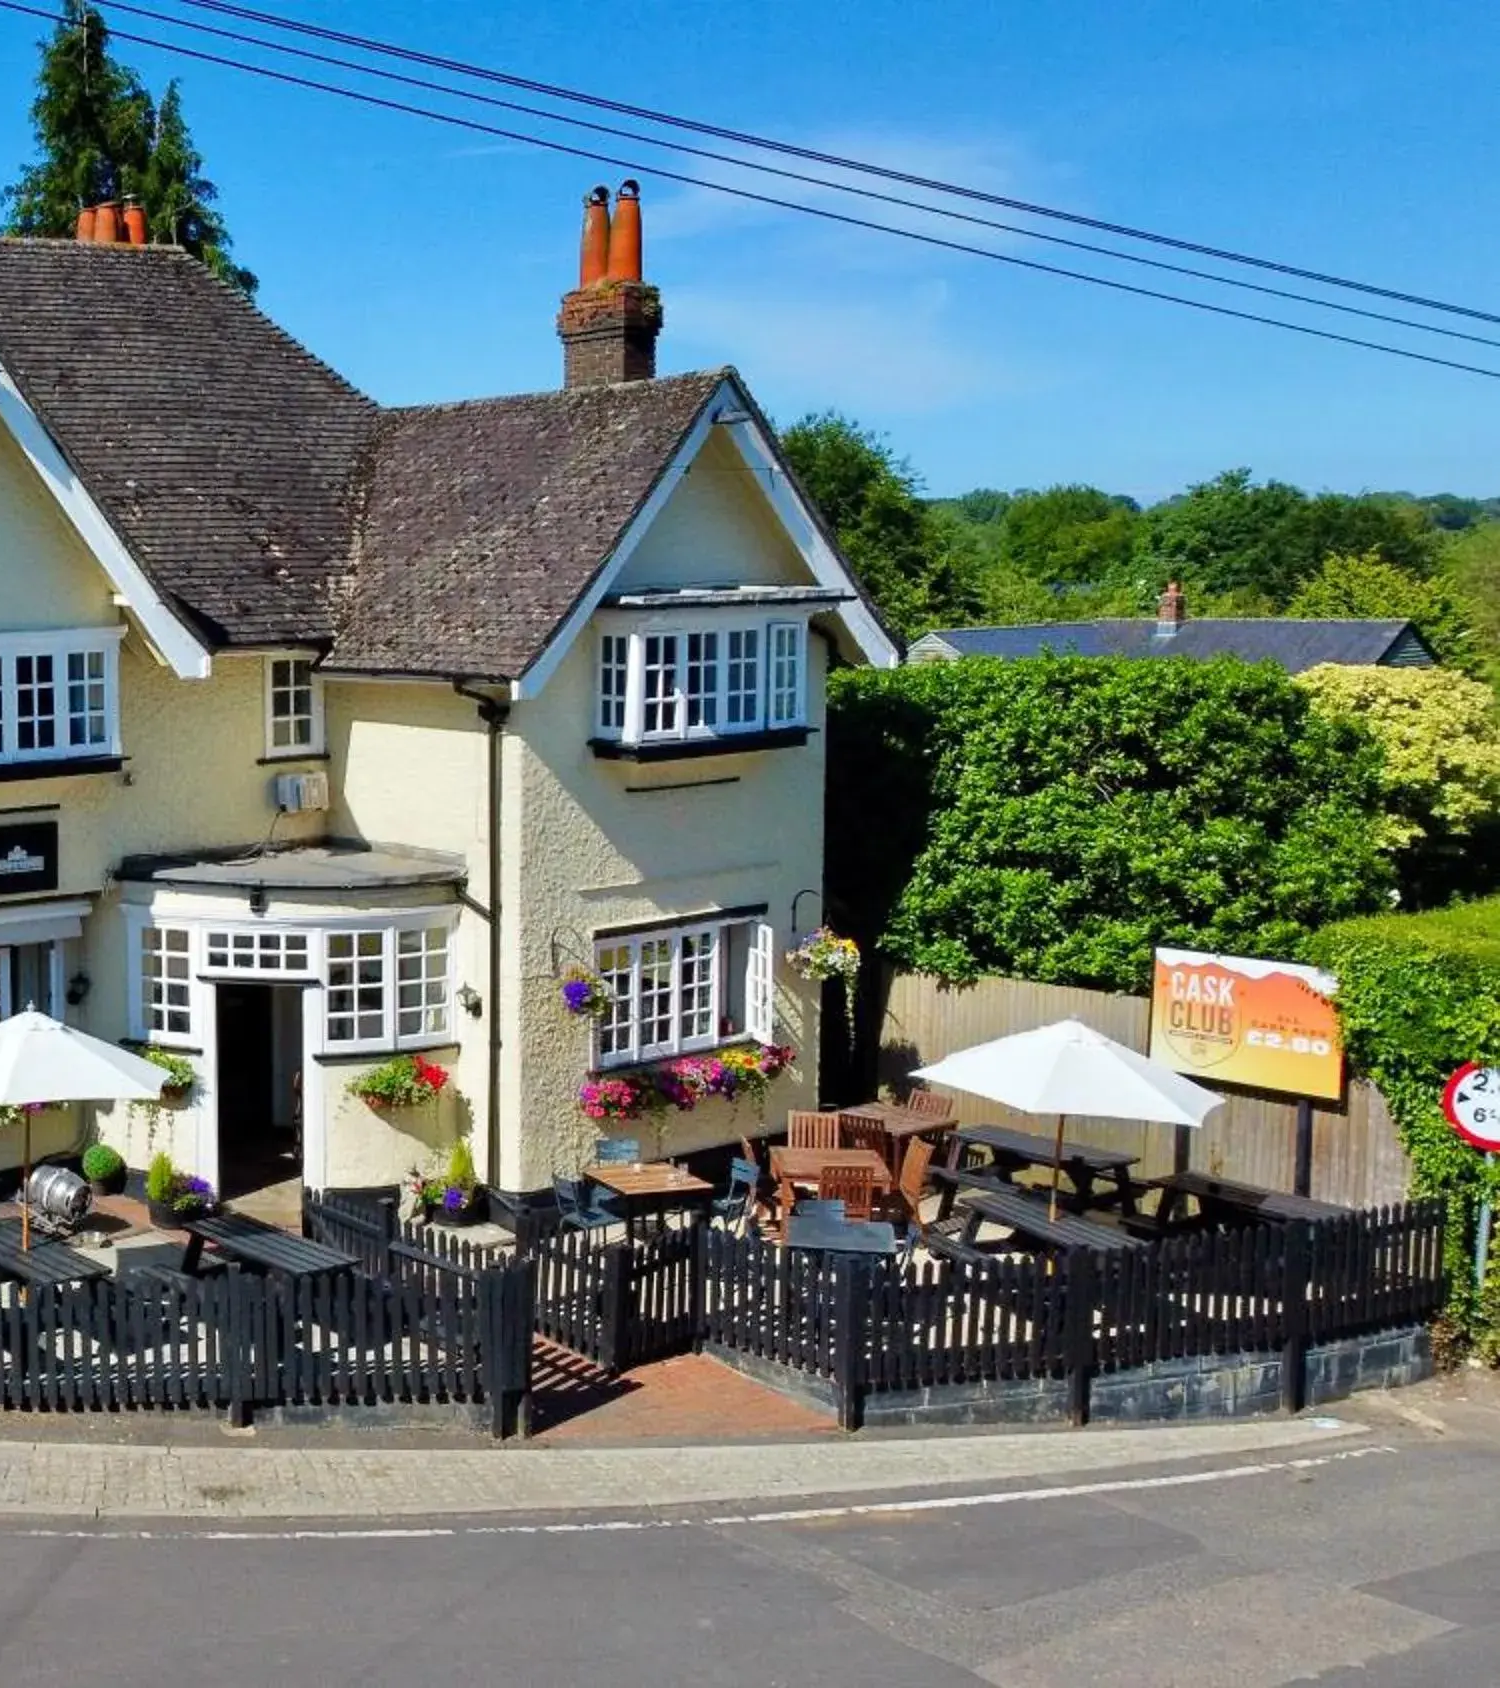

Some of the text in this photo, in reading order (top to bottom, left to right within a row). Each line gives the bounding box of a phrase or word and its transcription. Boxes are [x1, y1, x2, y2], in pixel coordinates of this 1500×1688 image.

[1171, 971, 1235, 1007] CASK
[1170, 1000, 1232, 1035] CLUB
[1473, 1073, 1500, 1094] 2.
